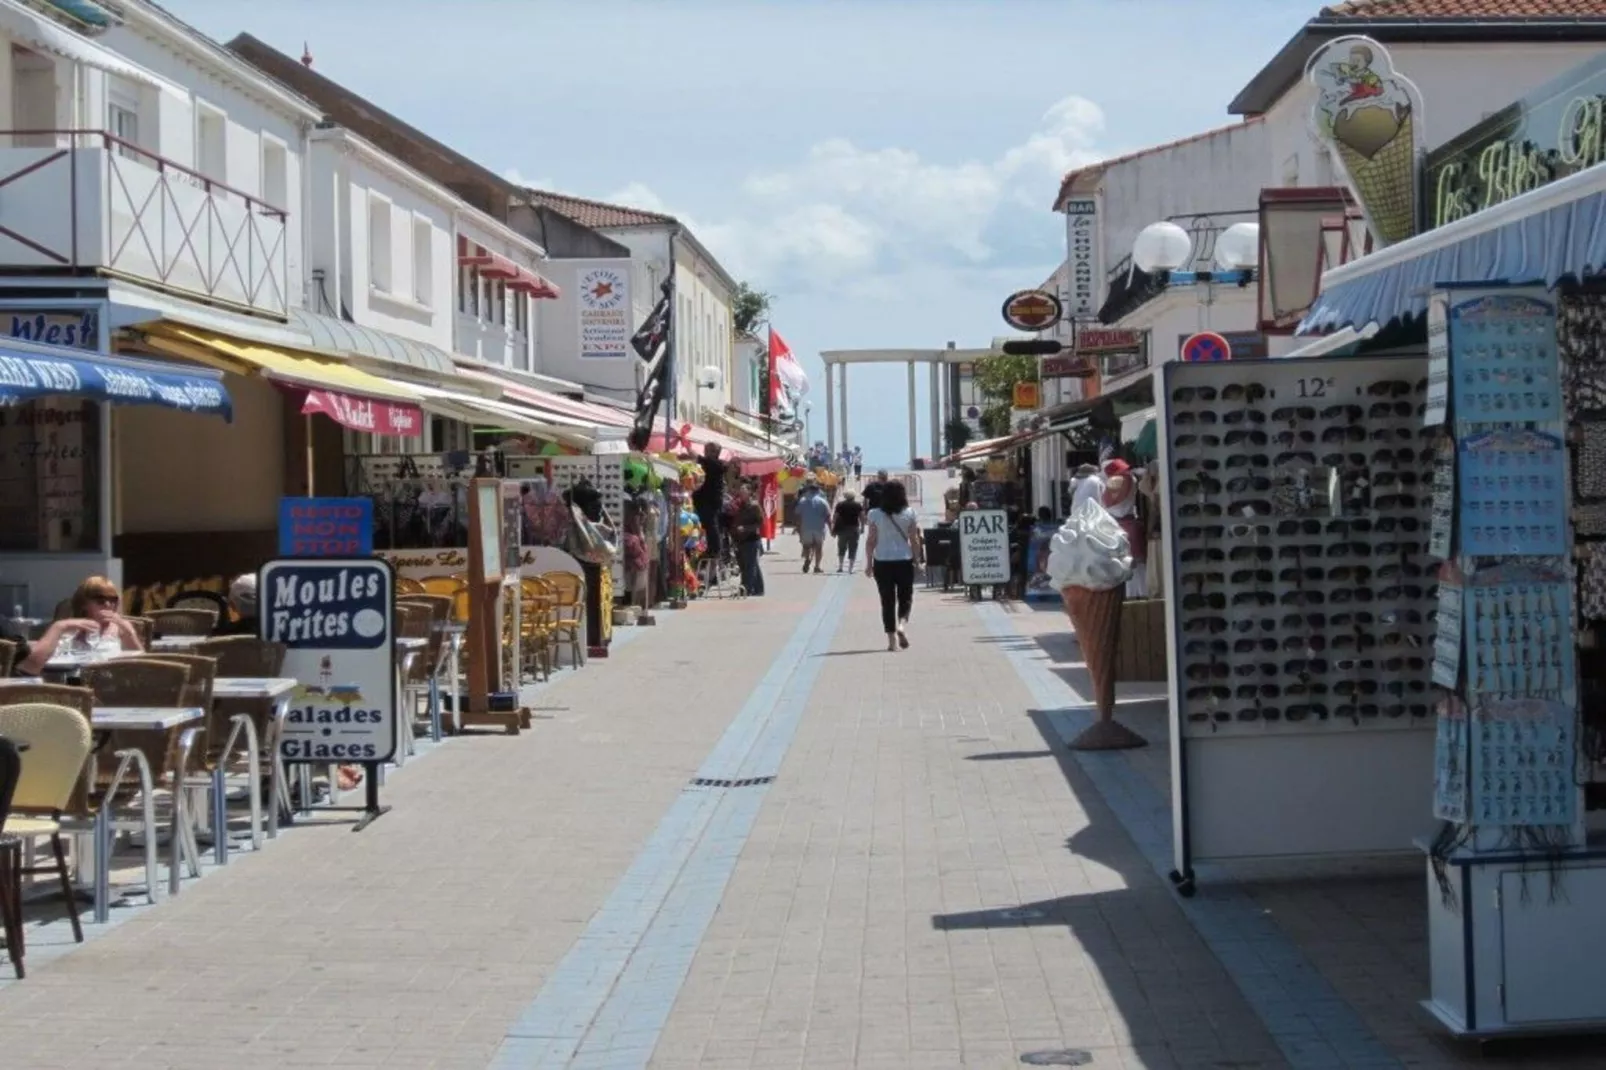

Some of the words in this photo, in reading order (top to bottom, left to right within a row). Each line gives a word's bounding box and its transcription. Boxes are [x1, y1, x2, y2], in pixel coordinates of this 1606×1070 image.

[1069, 203, 1094, 213] BAR
[294, 521, 360, 537] NON
[963, 515, 1005, 535] BAR
[294, 540, 361, 556] STOP
[273, 569, 380, 609] Moules
[271, 608, 350, 643] Frites
[280, 739, 377, 758] Glaces
